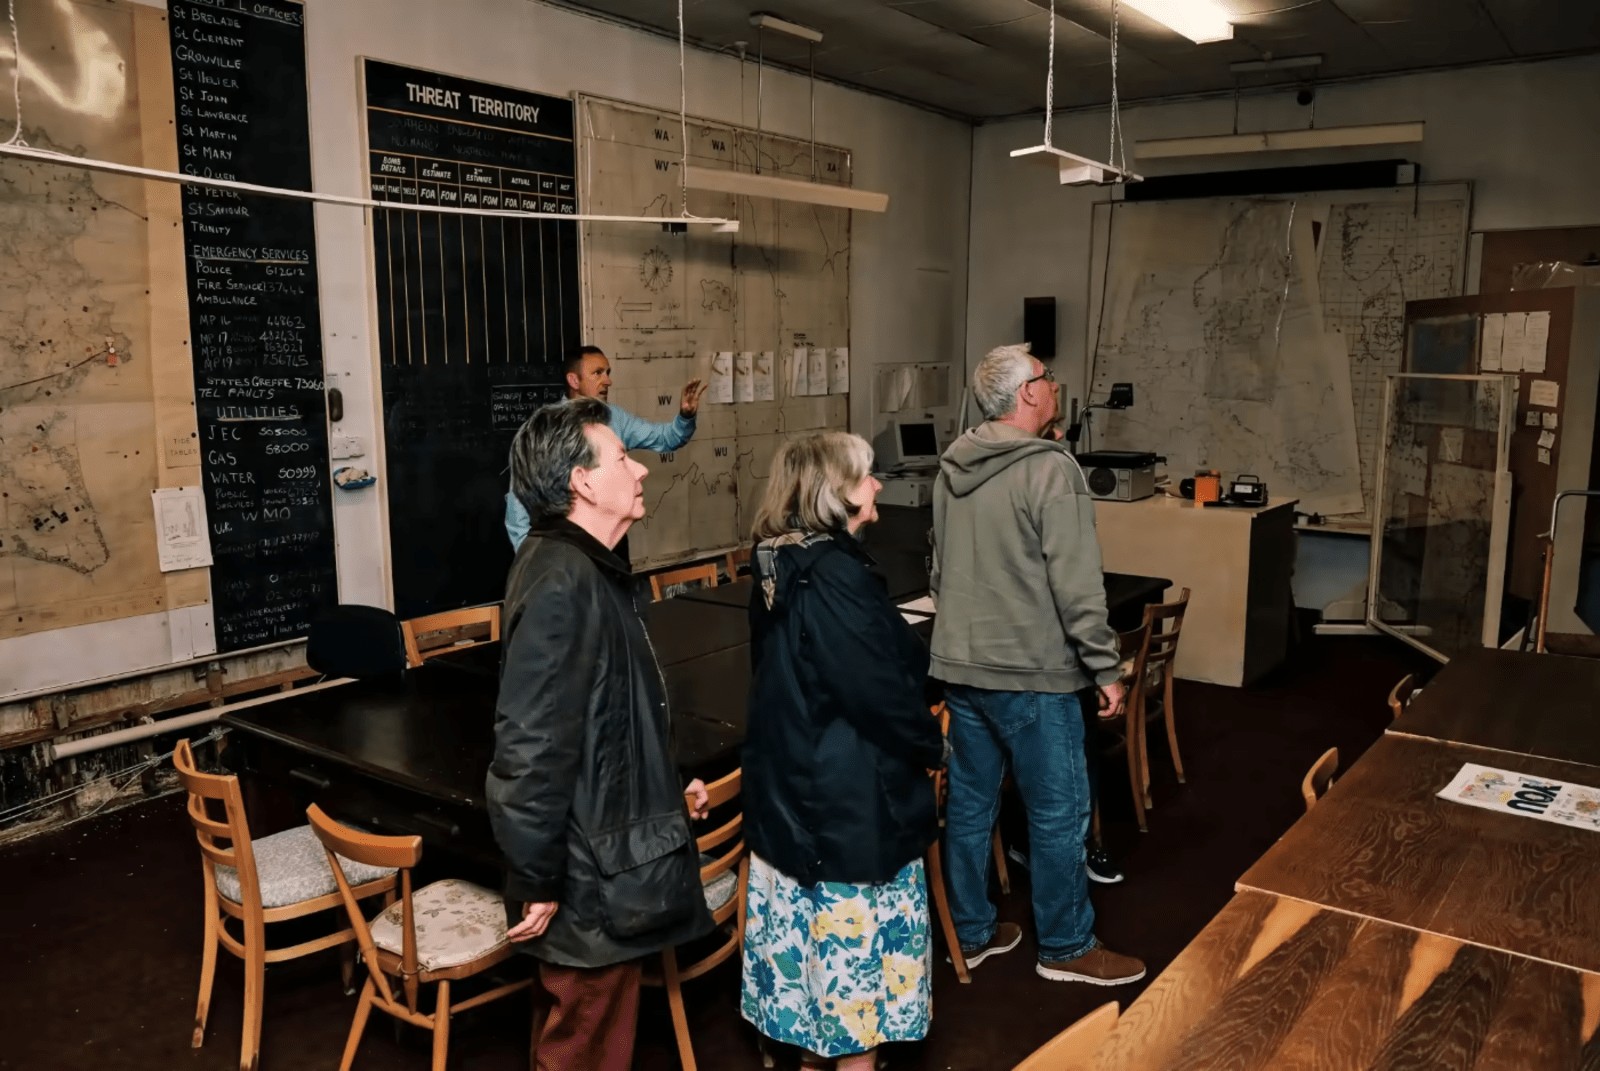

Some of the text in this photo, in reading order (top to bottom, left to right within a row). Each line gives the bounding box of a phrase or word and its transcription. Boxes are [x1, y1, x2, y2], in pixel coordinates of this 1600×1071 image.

[173, 5, 242, 28] St BRELADE
[174, 26, 244, 47] St CLEMENT
[175, 44, 242, 69] GROUVILLE
[179, 68, 239, 89] St HELIER
[180, 86, 195, 100] St
[406, 82, 540, 124] THREAT TERRITORY
[180, 104, 249, 123] St LAWRENCE
[182, 124, 237, 141] St MARTIN
[654, 129, 669, 141] WA
[711, 139, 726, 151] WA
[183, 144, 232, 160] St MARY
[381, 164, 406, 174] DETAILS
[655, 159, 669, 172] WV
[422, 168, 452, 179] ESTIMATE
[466, 174, 493, 184] ESTIMATE
[511, 177, 531, 186] ACTUAL
[542, 181, 553, 189] EST
[388, 185, 400, 194] TIME
[420, 188, 436, 199] FOA
[440, 190, 457, 201] FOM
[464, 193, 477, 203] FOA
[482, 195, 498, 206] FOM
[504, 197, 518, 208] FOA
[206, 202, 249, 217] SAVIOUR
[522, 200, 537, 210] FOM
[542, 201, 556, 212] FOC
[561, 204, 574, 214] FOC
[191, 220, 231, 236] TRINITY
[193, 244, 309, 261] EMERGENCY SERVICES
[195, 260, 232, 275] POLICE
[197, 278, 223, 290] FIRE
[196, 293, 257, 305] AMBULANCE
[199, 314, 217, 326] MP
[218, 331, 228, 346] 17
[207, 377, 250, 387] STATES
[251, 376, 293, 388] GREFFE
[199, 388, 276, 400] TEL FAULTS
[658, 395, 672, 406] WV
[216, 404, 299, 418] UTILITIES
[659, 452, 674, 463] WU
[714, 446, 728, 457] WU
[208, 450, 237, 466] GAS
[210, 471, 256, 485] WATER
[1506, 783, 1563, 814] YOU
